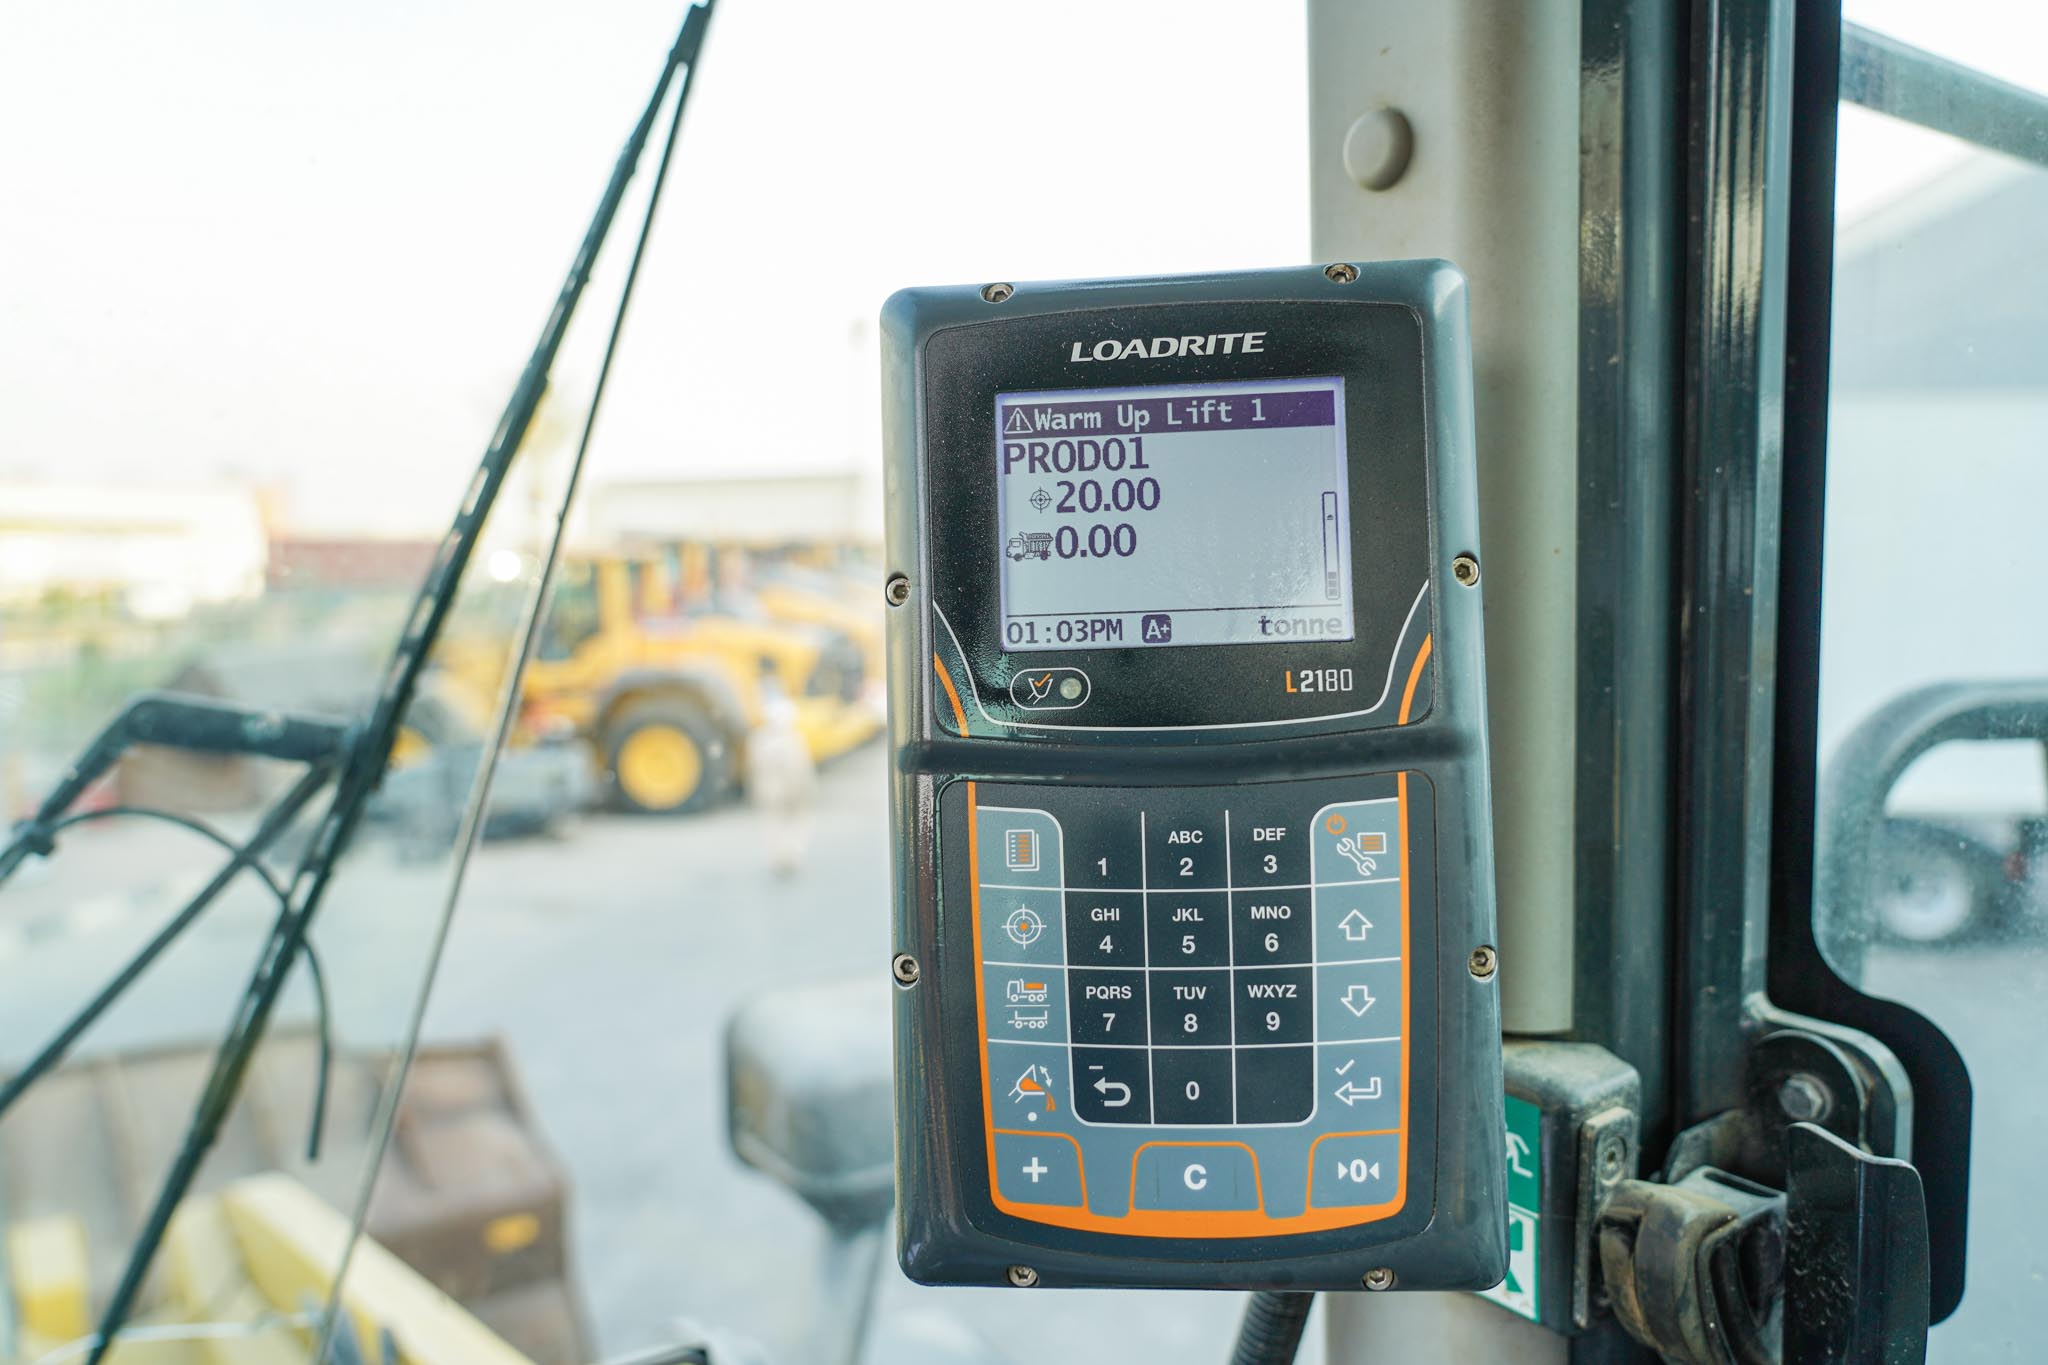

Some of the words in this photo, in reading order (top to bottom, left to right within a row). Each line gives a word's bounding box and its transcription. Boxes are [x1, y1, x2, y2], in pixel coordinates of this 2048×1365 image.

[1070, 331, 1267, 362] LOADRITE
[1034, 407, 1102, 430] Warm
[1117, 404, 1150, 431] Up
[1167, 401, 1233, 425] Lift
[1251, 398, 1266, 421] 1
[1003, 436, 1149, 475] PROD01
[1056, 477, 1161, 513] 20.00
[1055, 523, 1137, 559] 0.00
[1007, 618, 1123, 644] 01:03PM
[1258, 614, 1343, 637] tonne
[1285, 668, 1353, 693] L2180
[1168, 830, 1203, 844] ABC
[1253, 827, 1286, 842] DEF
[1097, 857, 1107, 876] 1
[1179, 857, 1194, 876] 2
[1263, 854, 1278, 874] 3
[1091, 908, 1120, 922] GHI
[1172, 908, 1204, 922] JKL
[1251, 905, 1291, 920] MNO
[1099, 935, 1113, 953] 4
[1181, 935, 1196, 954] 5
[1264, 933, 1279, 952] 6
[1086, 985, 1132, 999] PQRS
[1173, 986, 1207, 1000] TUV
[1248, 984, 1297, 999] WXYZ
[1102, 1012, 1116, 1031] 7
[1183, 1013, 1199, 1033] 8
[1265, 1011, 1281, 1031] 9
[1185, 1080, 1200, 1101] 0
[1183, 1163, 1208, 1191] C
